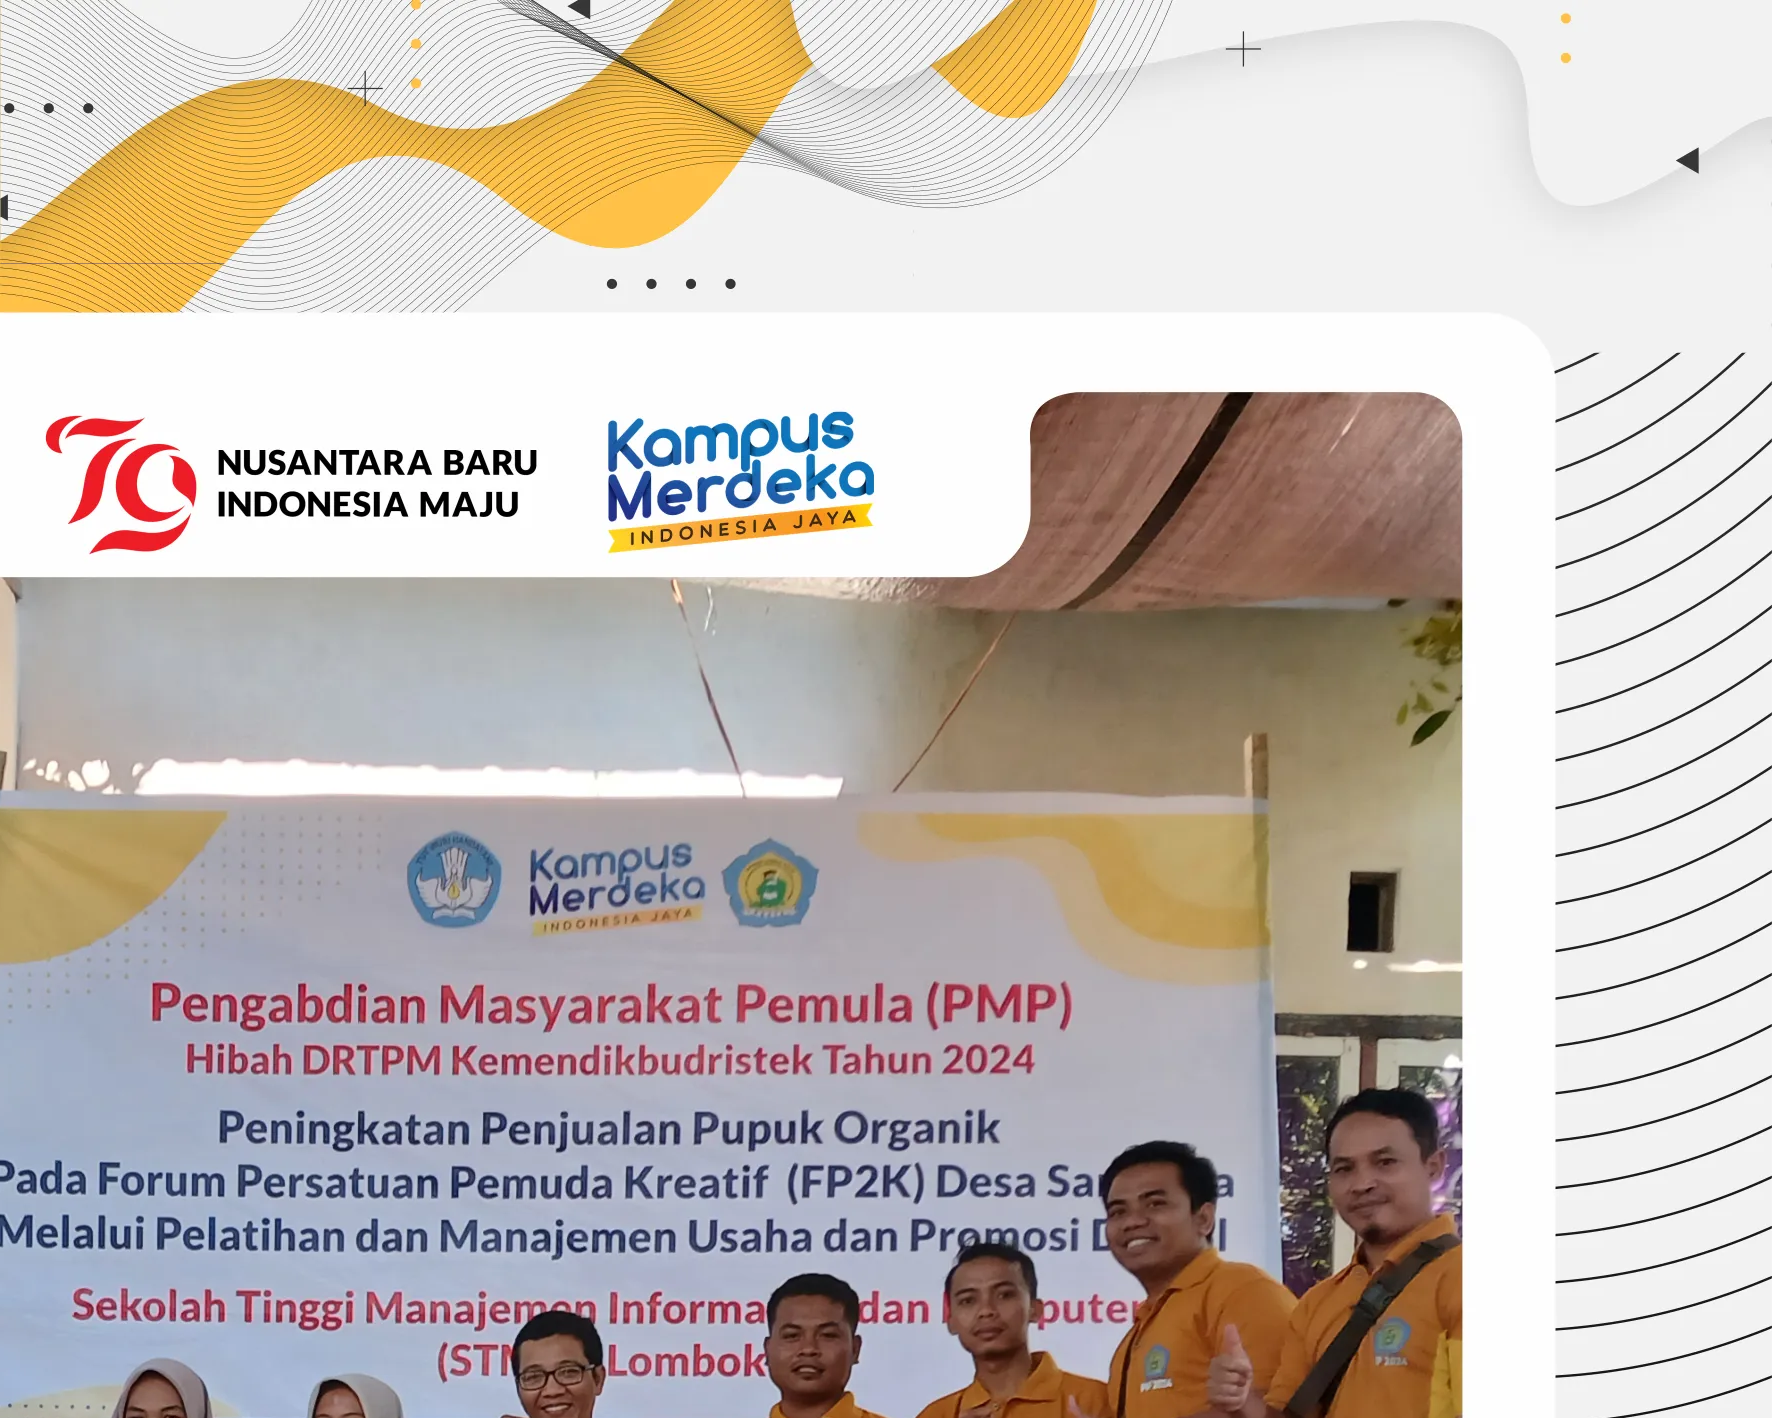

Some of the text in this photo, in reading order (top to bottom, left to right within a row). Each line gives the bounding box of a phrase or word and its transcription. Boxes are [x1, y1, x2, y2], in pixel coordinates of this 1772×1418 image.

[530, 843, 693, 883] Kampus
[529, 872, 706, 916] Merdeka
[542, 907, 693, 933] INDONESIA JAYA
[151, 981, 1072, 1033] Pengabdian Masyarakat Pemula (PMP)
[186, 1043, 1035, 1076] Hibah DRTPM Kemendikbudristek Tahun 2024
[219, 1109, 1001, 1153] Peningkatan Penjualan Pupuk Organik
[98, 1161, 225, 1198] Forum
[237, 1163, 439, 1199] Persatuan
[450, 1164, 613, 1200] Pemuda
[625, 1163, 770, 1199] Kreatif
[787, 1162, 925, 1205] (FP2K)
[936, 1164, 1036, 1198] Desa
[156, 1216, 345, 1253] Pelatihan
[355, 1218, 428, 1253] dan
[440, 1218, 676, 1261] Manajemen
[688, 1218, 812, 1254] Usaha
[823, 1217, 898, 1253] dan
[910, 1217, 1080, 1252] Promosi
[72, 1287, 226, 1323] Sekolah
[235, 1289, 354, 1332] Tinggi
[859, 1290, 930, 1324] dan
